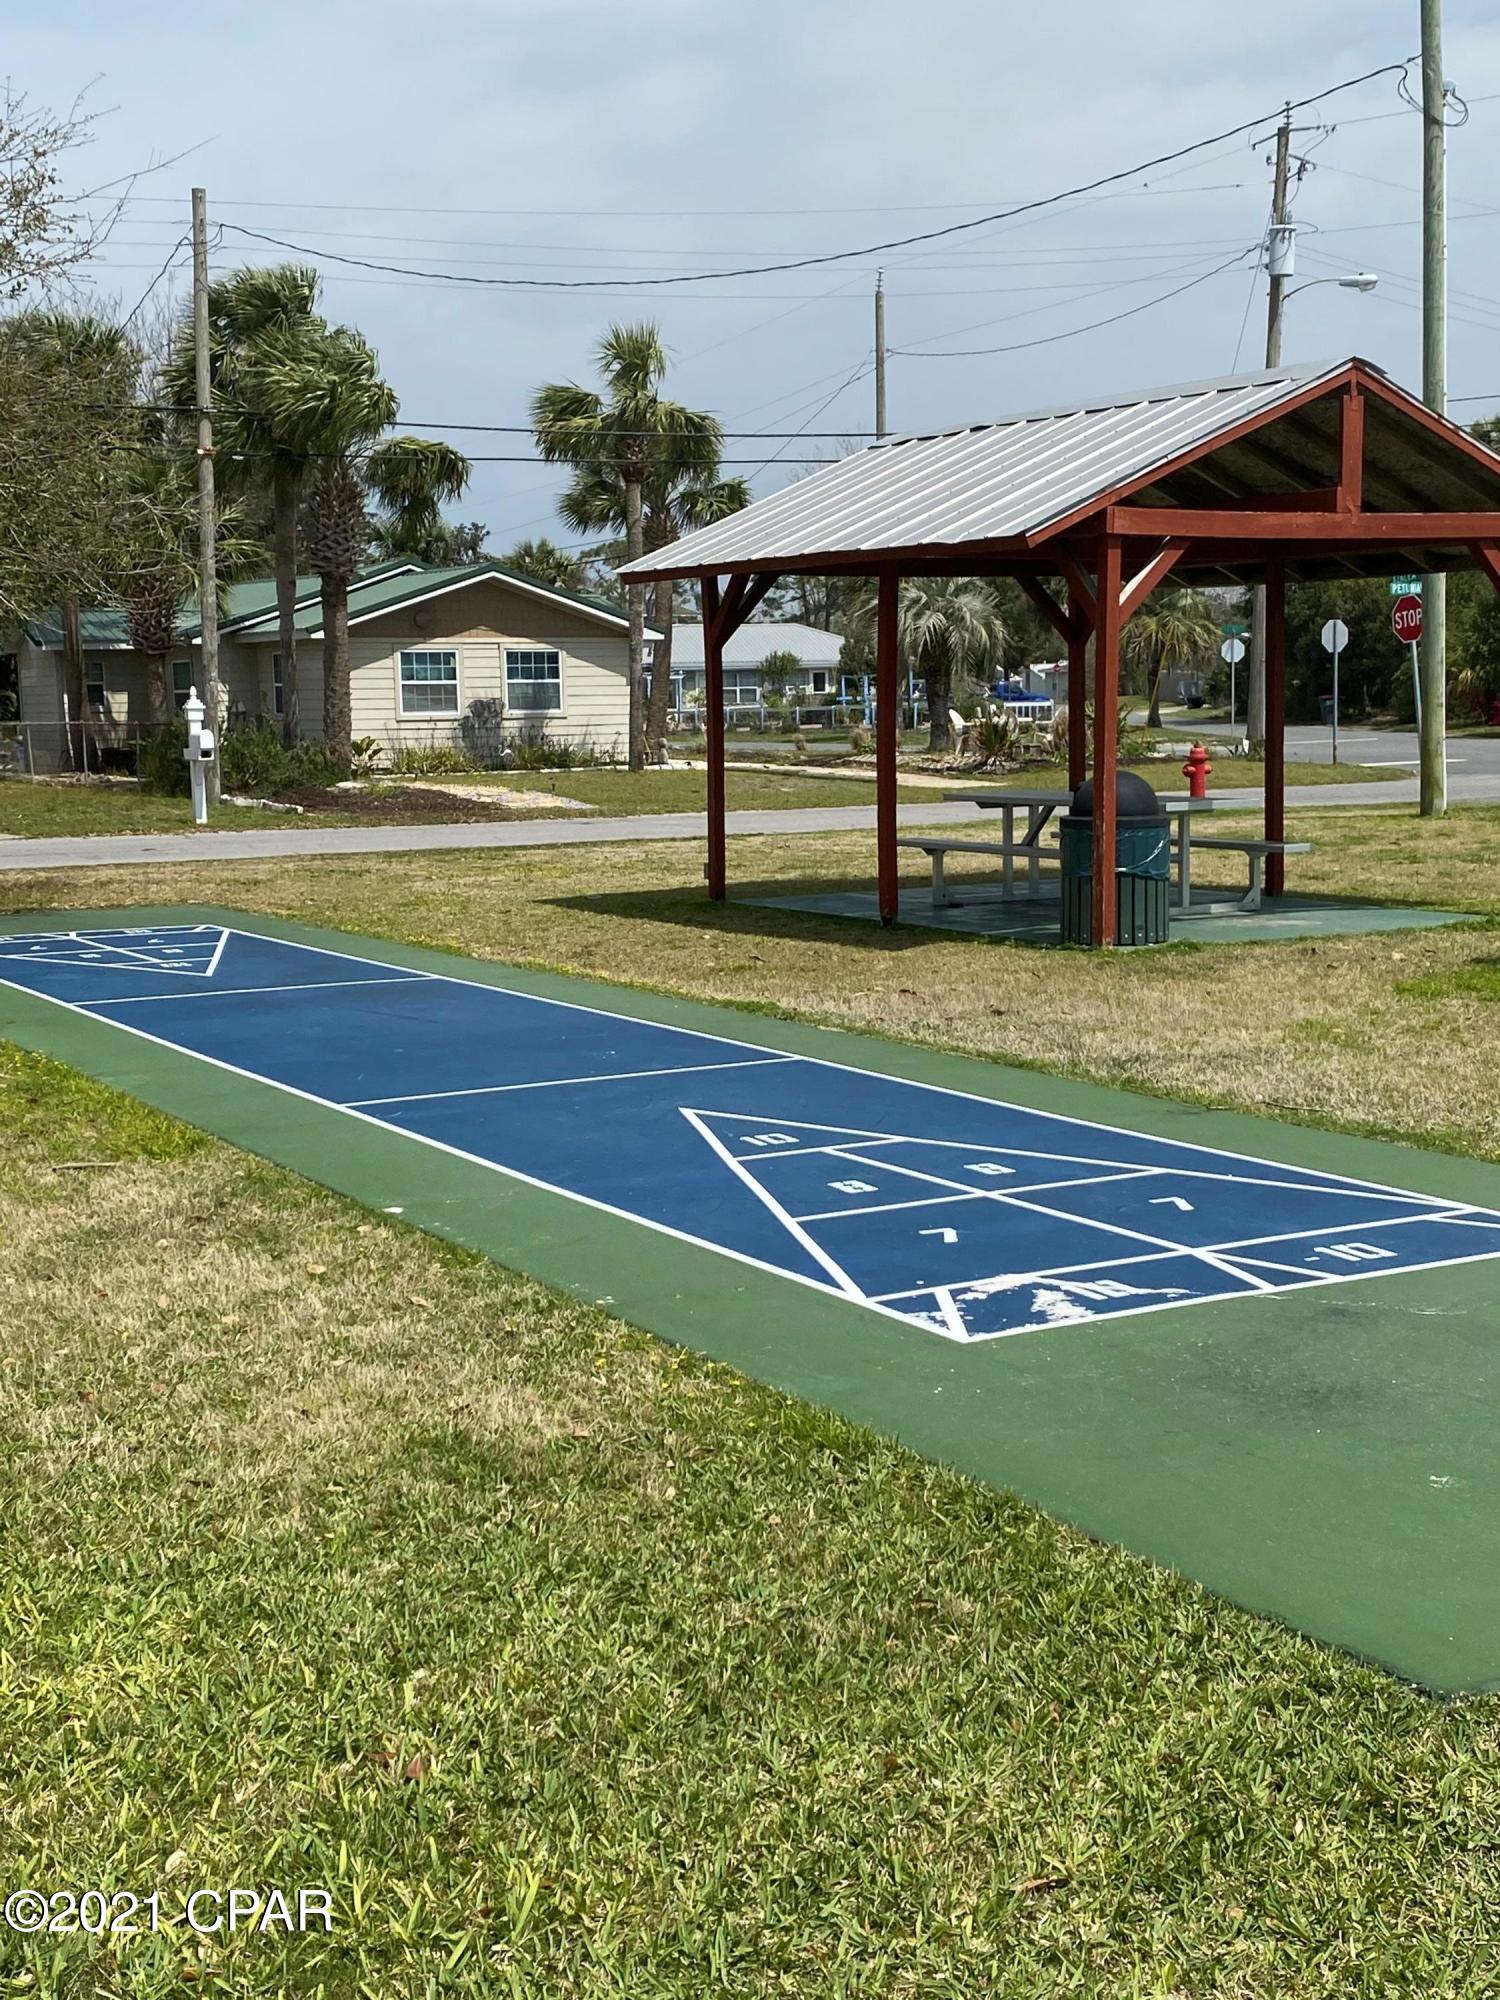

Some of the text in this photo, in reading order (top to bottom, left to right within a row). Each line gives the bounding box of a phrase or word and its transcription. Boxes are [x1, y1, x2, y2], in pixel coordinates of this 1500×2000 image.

[1395, 608, 1422, 629] STOP
[740, 1133, 800, 1146] 10
[963, 1162, 1016, 1175] 8
[827, 1179, 878, 1194] 8
[1149, 1196, 1195, 1211] 7
[918, 1227, 958, 1243] 7
[1303, 1242, 1398, 1262] -10
